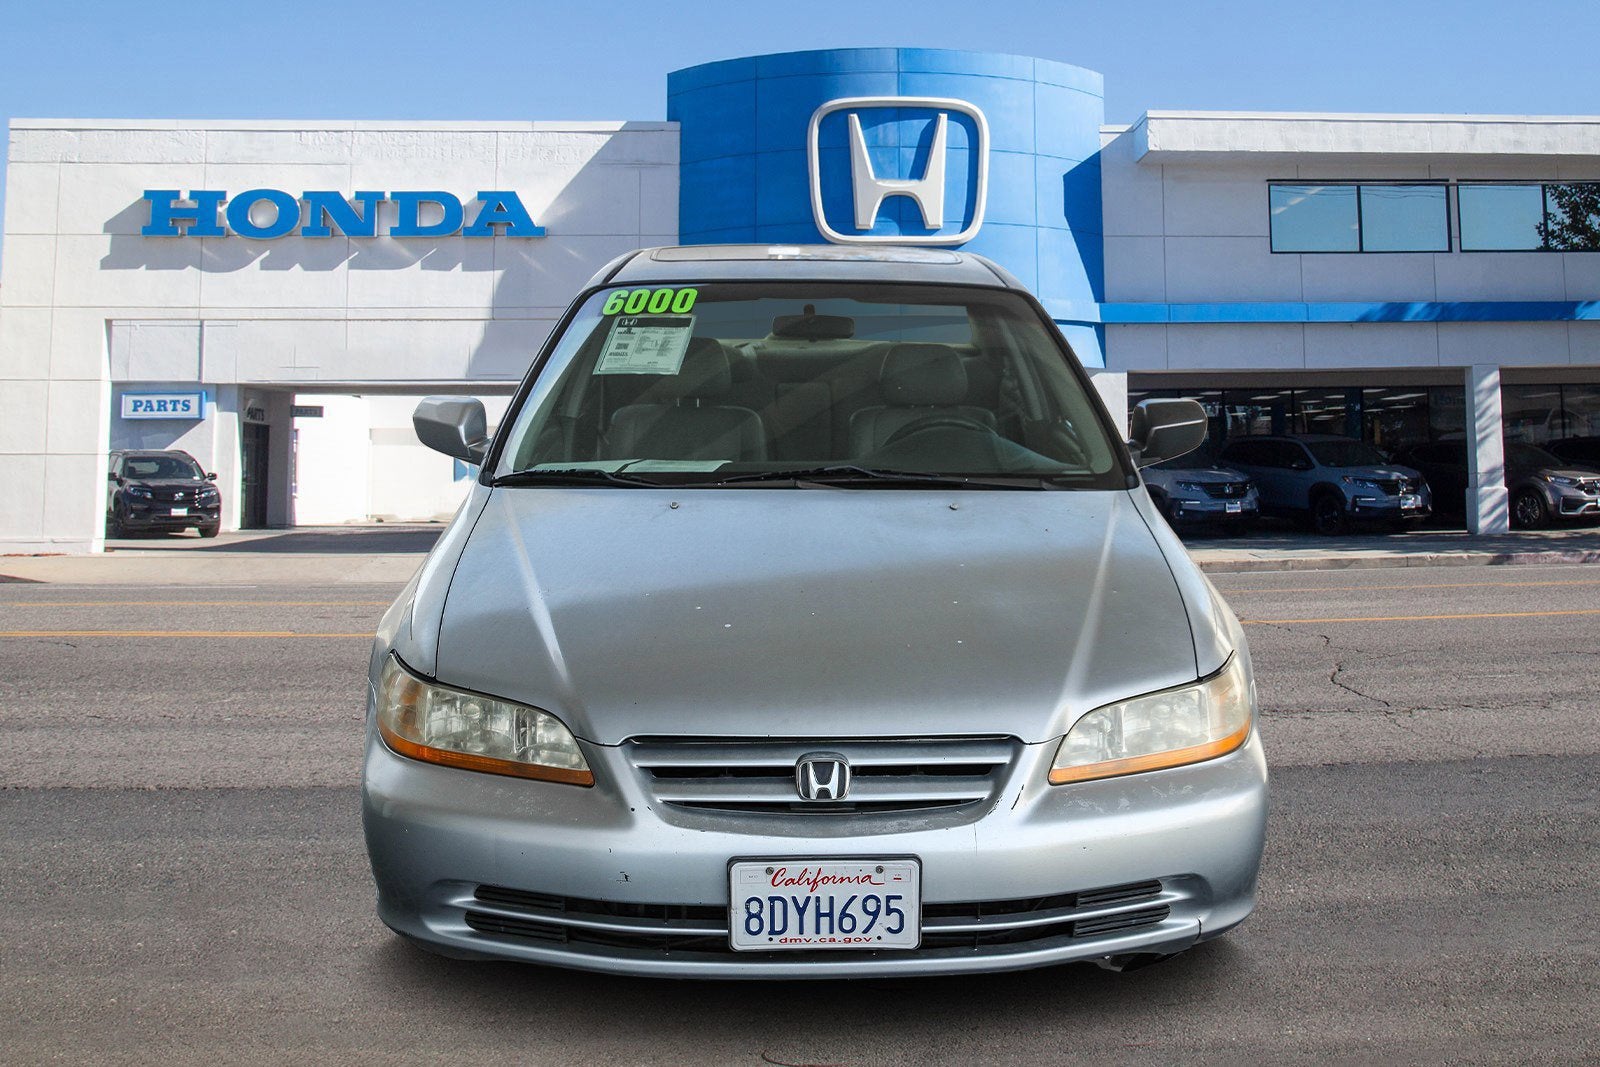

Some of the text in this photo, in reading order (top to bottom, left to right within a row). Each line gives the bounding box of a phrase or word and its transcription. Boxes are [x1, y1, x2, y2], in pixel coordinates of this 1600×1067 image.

[141, 188, 547, 240] HONDA
[602, 287, 698, 316] 6000
[131, 399, 191, 413] PARTS
[771, 867, 885, 892] California
[744, 894, 905, 936] 8DYH695
[778, 936, 873, 944] dmv.ca.gov
